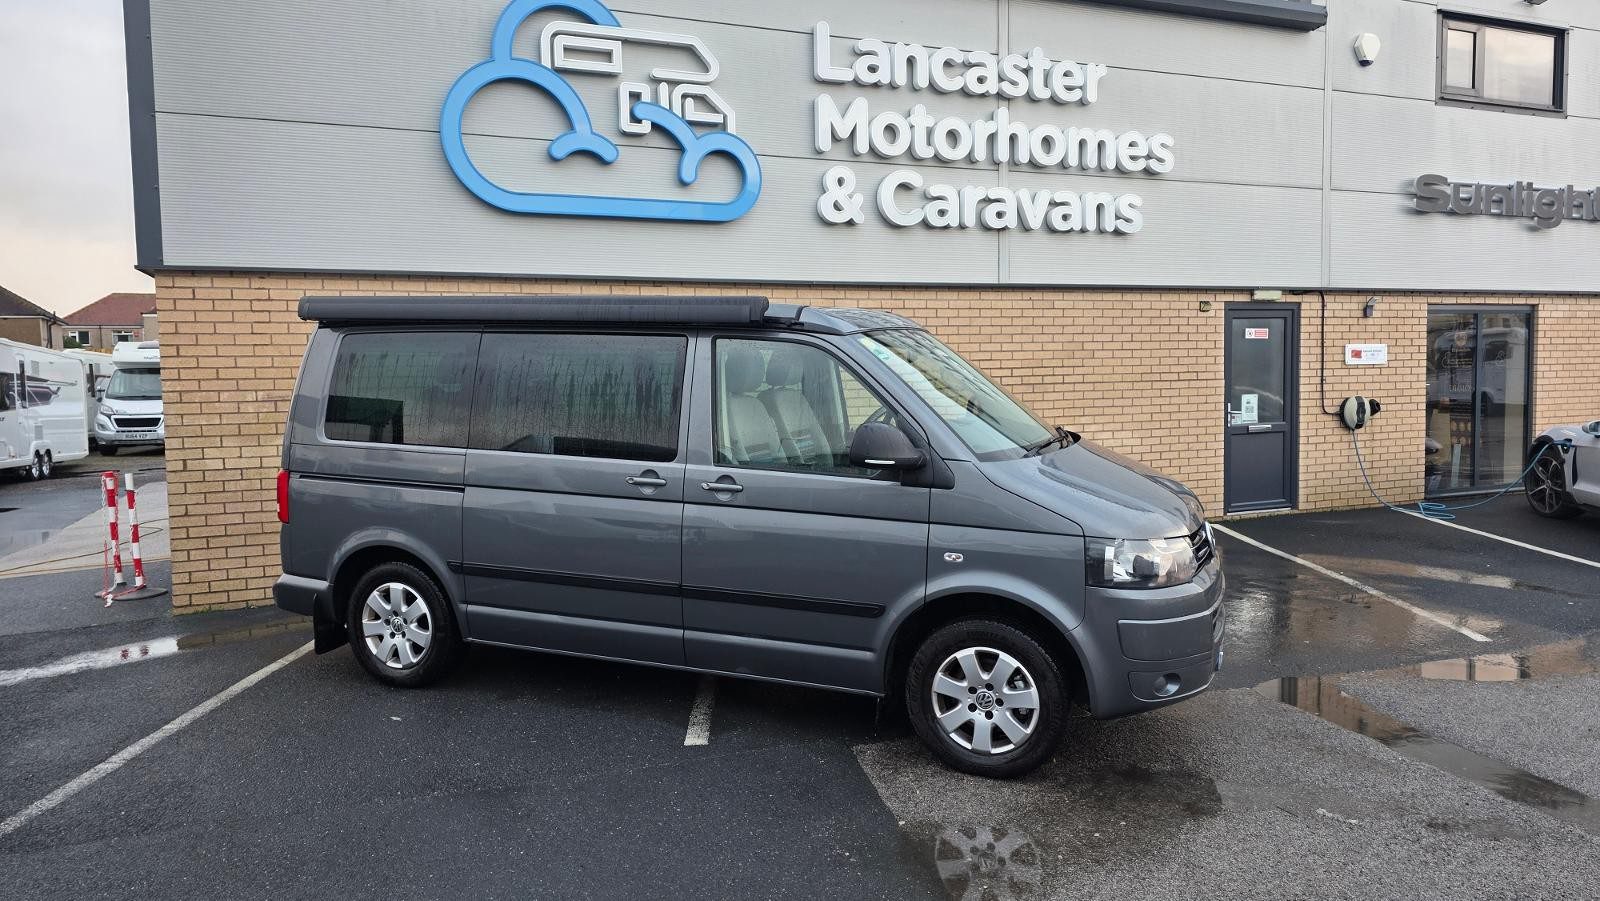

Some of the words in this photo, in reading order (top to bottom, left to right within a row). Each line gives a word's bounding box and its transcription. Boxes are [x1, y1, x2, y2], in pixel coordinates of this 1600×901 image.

[813, 20, 1107, 104] Lancaster
[814, 93, 1175, 174] Motorhomes
[816, 165, 865, 225] &
[876, 169, 1144, 234] Caravans
